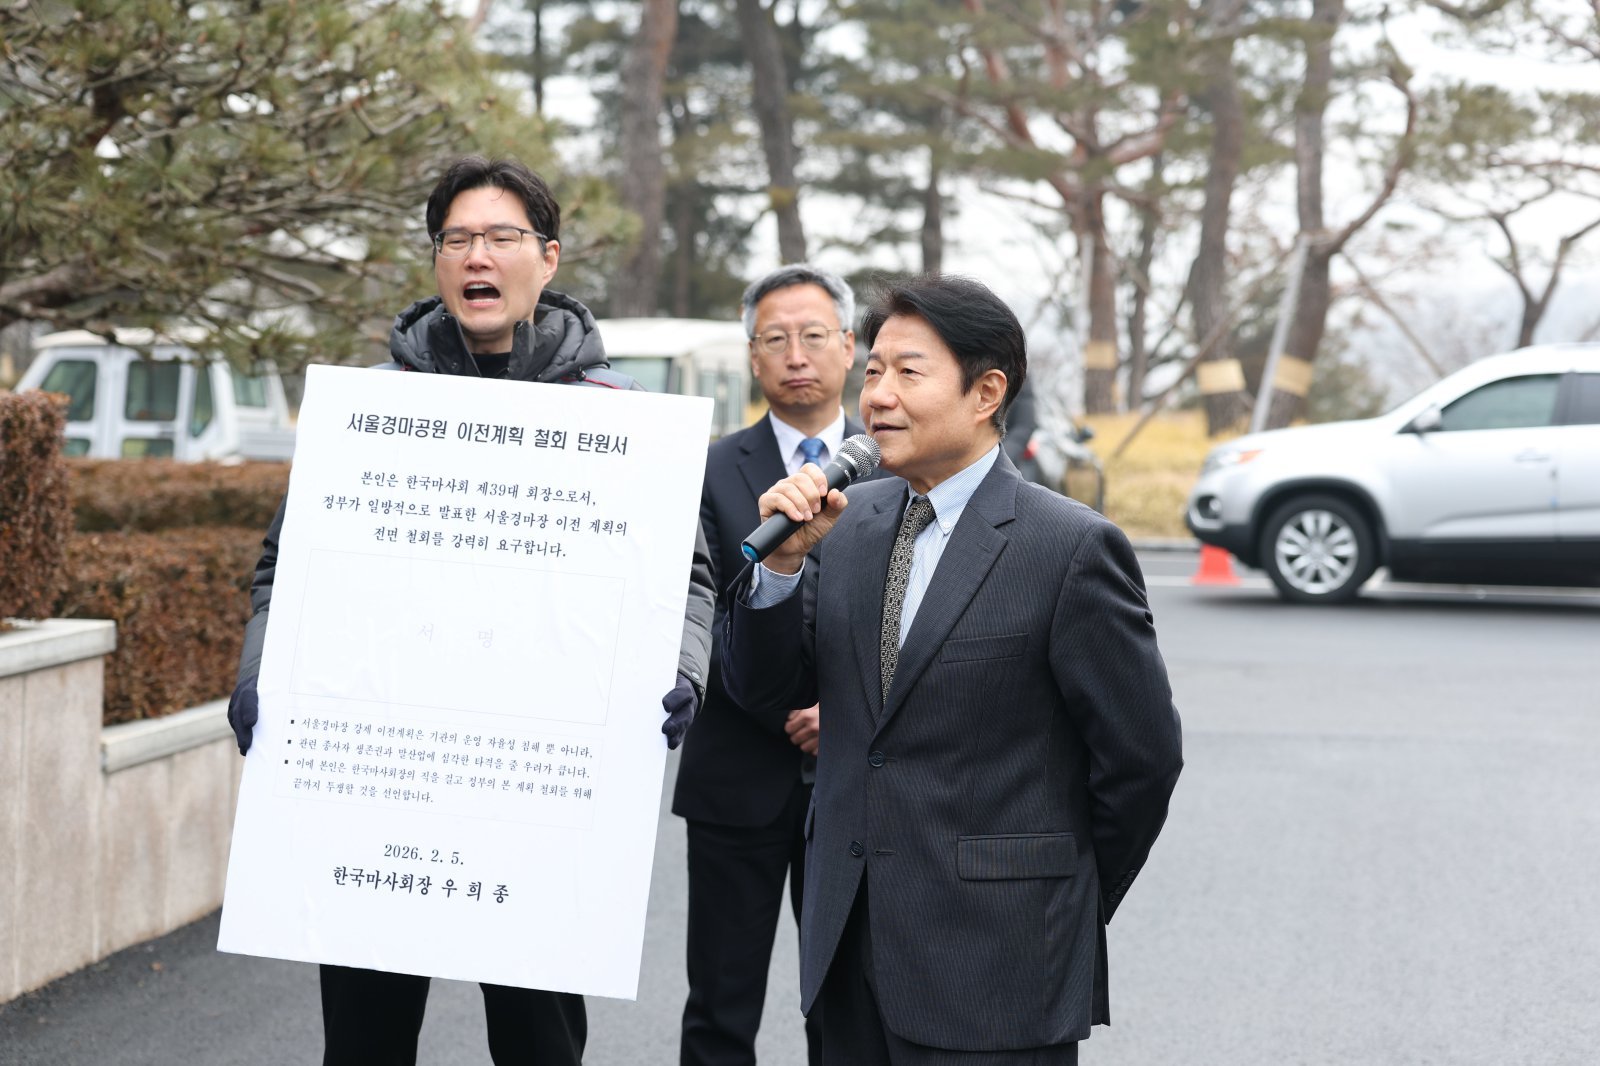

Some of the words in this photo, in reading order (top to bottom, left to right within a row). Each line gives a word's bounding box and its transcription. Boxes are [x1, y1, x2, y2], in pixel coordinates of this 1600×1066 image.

[345, 413, 448, 439] 서울경마공원
[457, 422, 524, 446] 이전계획
[534, 429, 567, 450] 철회
[578, 433, 628, 456] 탄원서
[361, 471, 399, 487] 본인은
[406, 475, 469, 495] 한국마사회
[476, 481, 519, 499] 제39대
[526, 486, 596, 507] 회장으로서,
[323, 494, 361, 512] 정부가
[368, 499, 431, 516] 일방적으로
[439, 505, 477, 522] 발표한
[483, 509, 549, 529] 서울경마장
[556, 516, 580, 532] 이전
[588, 519, 627, 536] 계획의
[373, 526, 398, 542] 전면
[406, 529, 444, 547] 철회를
[451, 533, 488, 551] 강력히
[496, 536, 566, 558] 요구합니다.
[299, 738, 316, 750] 관련
[323, 740, 350, 753] 종사자
[356, 744, 393, 758] 생존권과
[399, 748, 435, 762] 말산업에
[442, 753, 469, 766] 심각한
[475, 756, 503, 769] 타격을
[509, 760, 518, 771] 줄
[302, 718, 349, 733] 서울경마장
[378, 726, 424, 740] 이전계획은
[430, 731, 457, 744] 기관의
[463, 735, 481, 747] 운영
[488, 736, 515, 751] 자율성
[521, 741, 540, 752] 침해
[561, 745, 592, 759] 아니라,
[293, 778, 320, 791] 끝까지
[360, 784, 378, 799] 것을
[383, 788, 433, 803] 선언합니다.
[297, 758, 314, 770] 이에
[320, 760, 346, 773] 본인은
[352, 764, 415, 781] 한국마사회장의
[421, 771, 439, 783] 직을
[469, 776, 495, 789] 정부의
[501, 780, 511, 790] 본
[516, 781, 534, 794] 계획
[541, 784, 568, 797] 철회를
[573, 788, 592, 800] 위해
[384, 844, 422, 860] 2026.
[430, 849, 443, 863] 2.
[451, 851, 464, 865] 5.
[333, 865, 432, 895] 한국마사회장
[441, 878, 458, 898] 우
[466, 881, 482, 902] 희
[492, 884, 509, 904] 종
